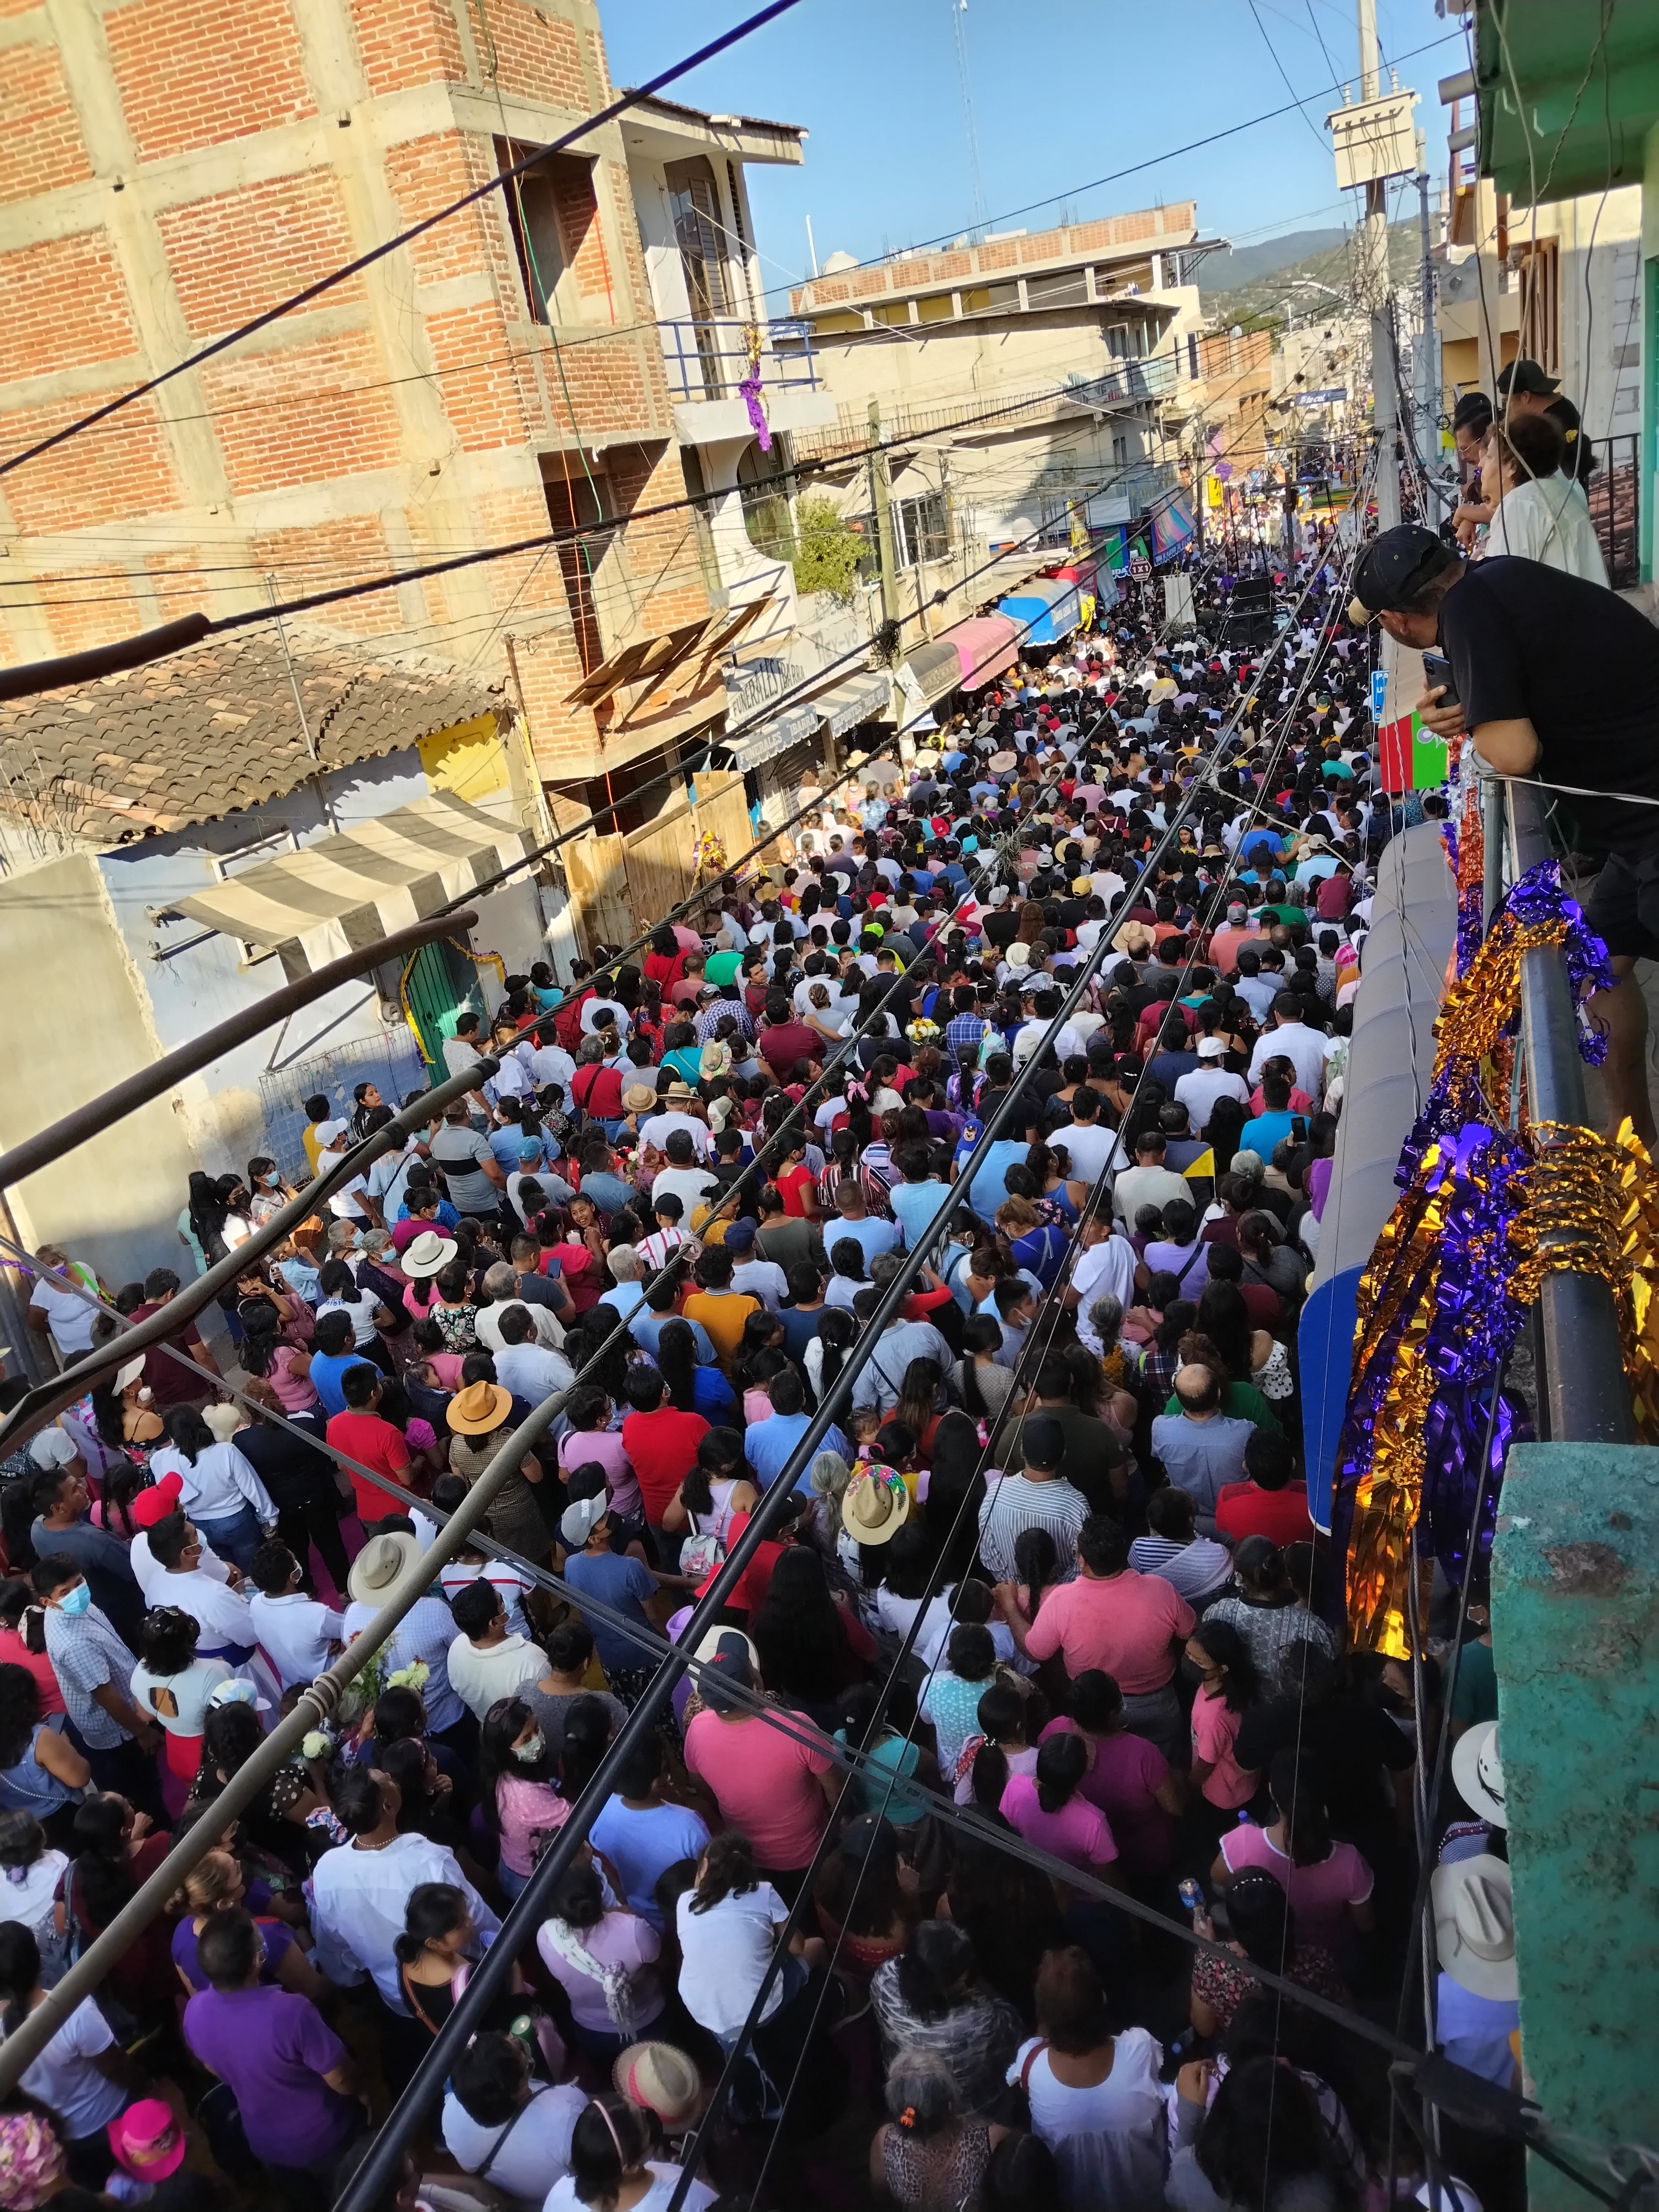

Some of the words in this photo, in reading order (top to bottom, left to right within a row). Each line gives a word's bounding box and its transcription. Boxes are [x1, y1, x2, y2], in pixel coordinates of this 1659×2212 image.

[732, 658, 779, 716] FUNERALES
[776, 660, 805, 691] IBARRA
[832, 701, 863, 731] DEPORTES
[739, 731, 782, 765] FUNERALES
